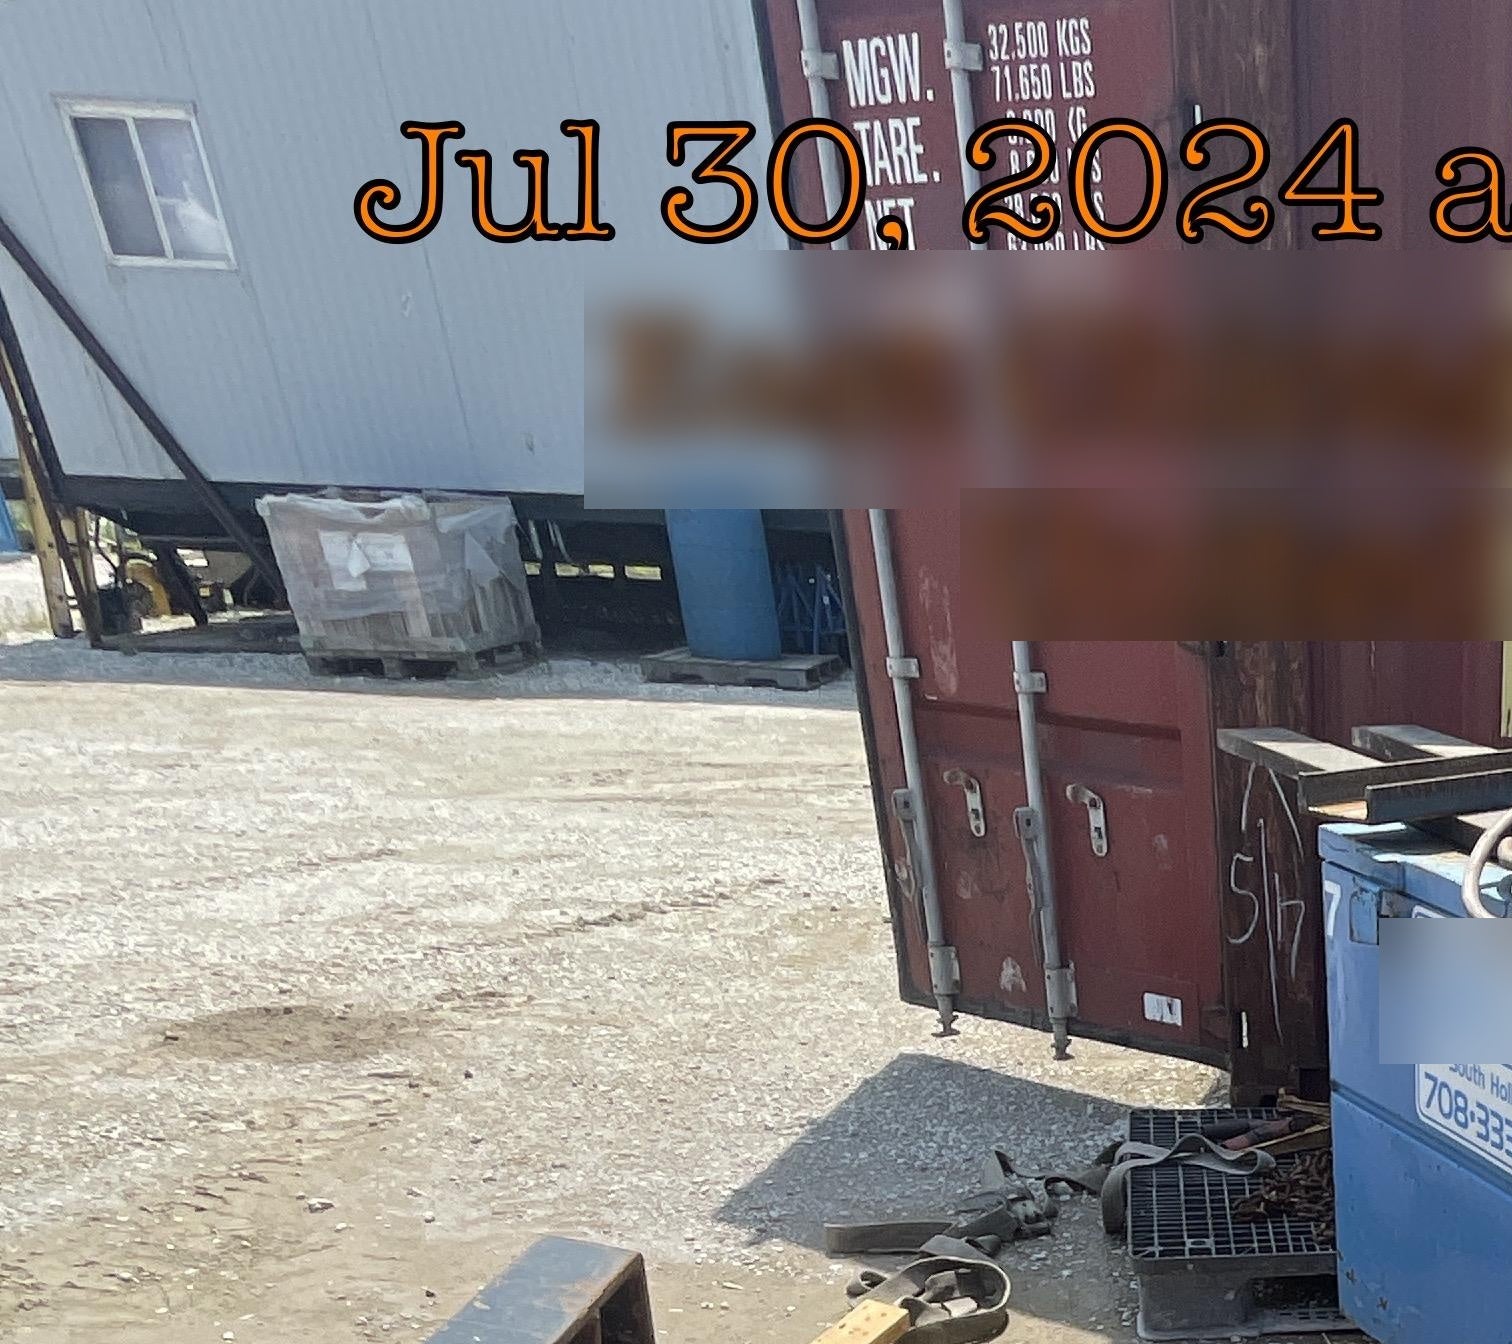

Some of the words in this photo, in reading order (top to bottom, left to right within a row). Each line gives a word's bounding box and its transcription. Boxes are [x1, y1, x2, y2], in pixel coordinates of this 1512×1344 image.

[1056, 17, 1092, 56] KGS
[842, 32, 935, 108] MGW.
[1060, 59, 1095, 99] LBS
[1322, 880, 1343, 938] 7
